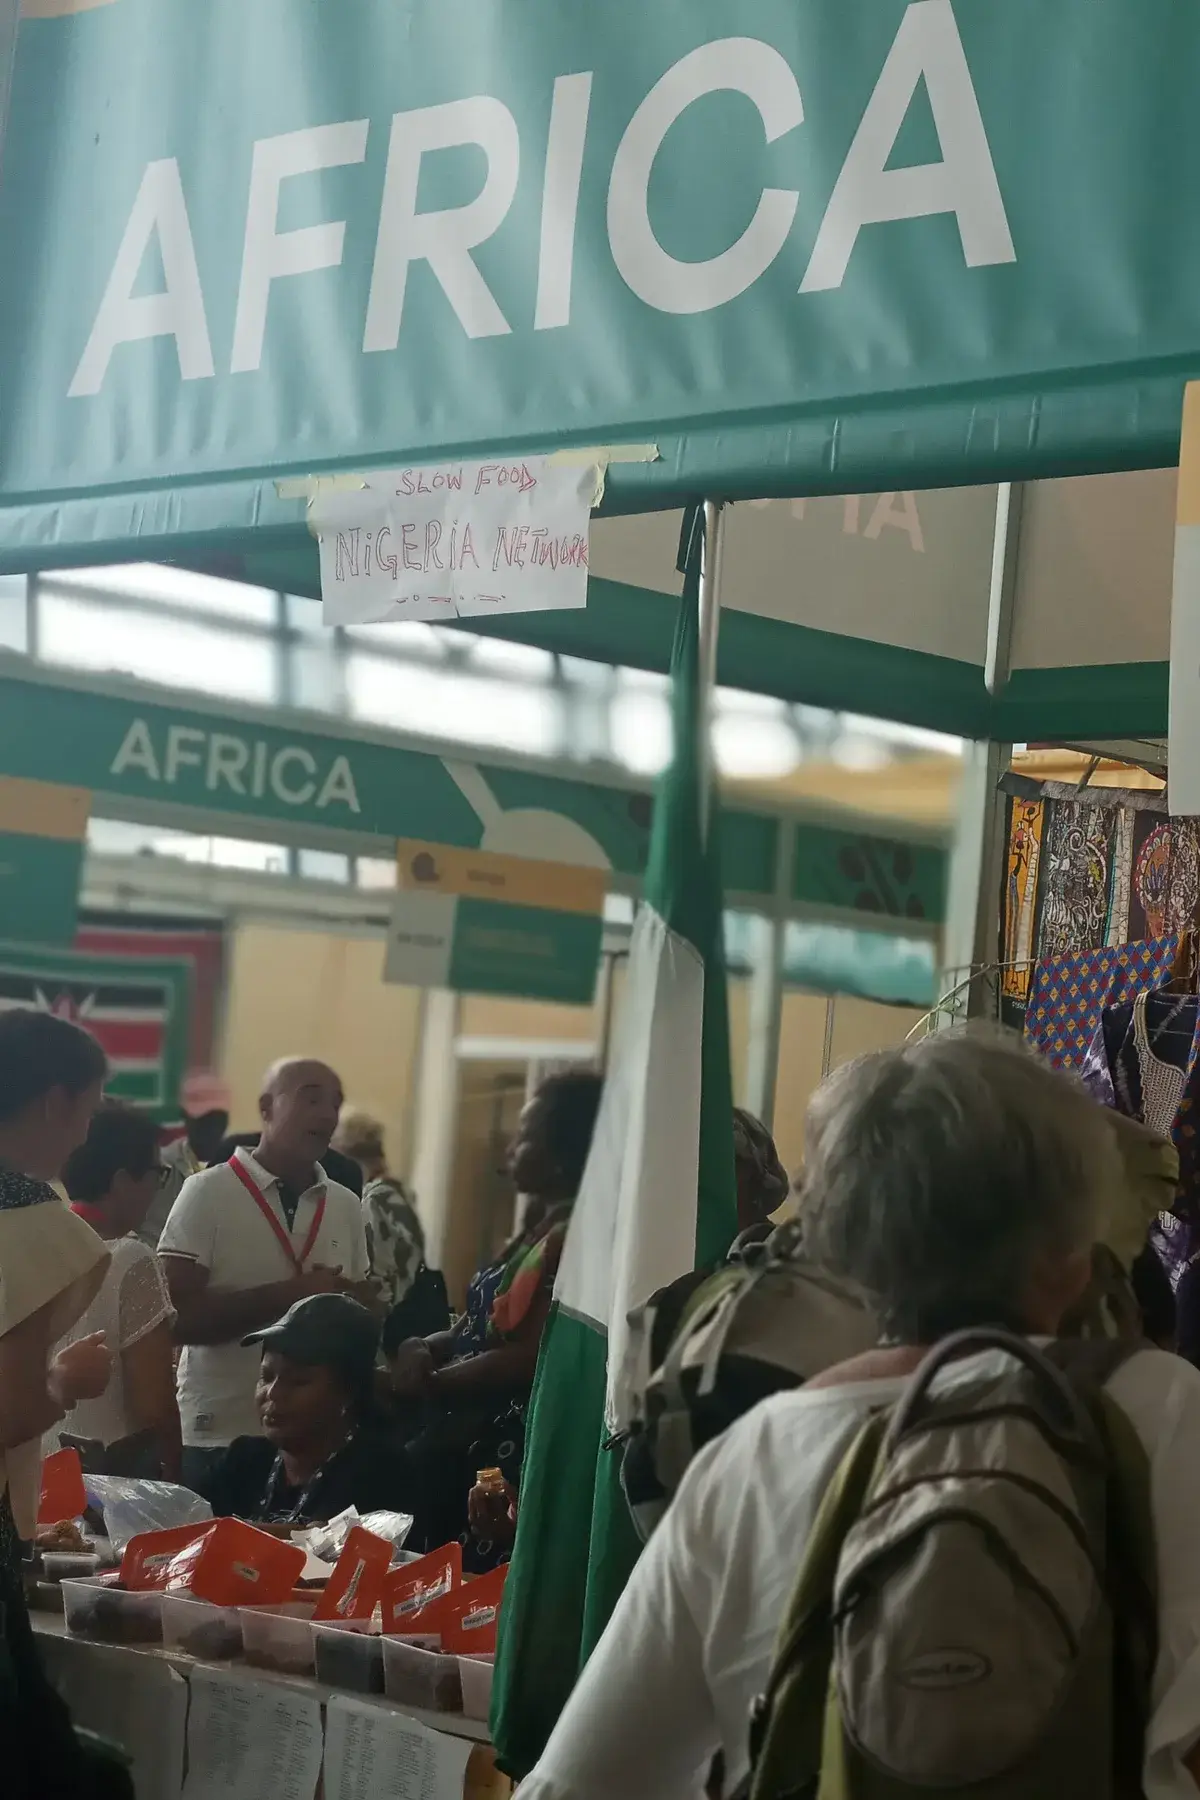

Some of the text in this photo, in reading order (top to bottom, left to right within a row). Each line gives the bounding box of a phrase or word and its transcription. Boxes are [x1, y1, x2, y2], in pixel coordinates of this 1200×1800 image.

[67, 0, 1016, 398] AFRICA
[396, 463, 537, 497] SLOW FOOD
[110, 718, 361, 813] AFRICA
